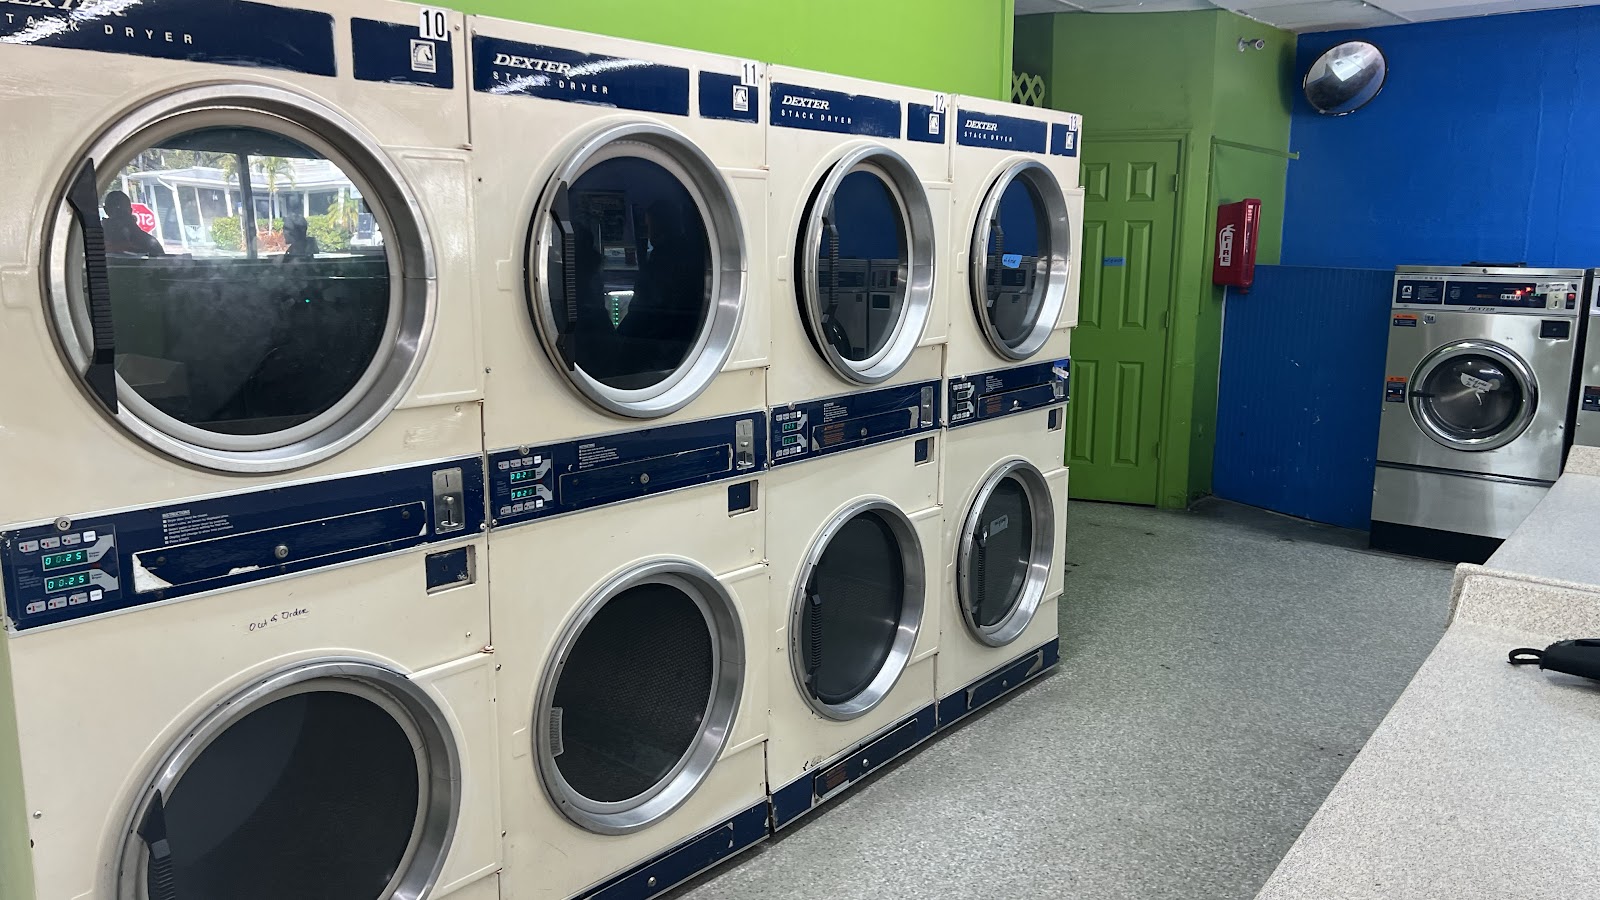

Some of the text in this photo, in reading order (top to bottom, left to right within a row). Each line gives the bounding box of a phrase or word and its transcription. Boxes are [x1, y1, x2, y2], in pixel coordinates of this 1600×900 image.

[422, 10, 446, 38] 10
[104, 24, 193, 44] DRYER
[493, 53, 572, 75] DEXTER
[743, 63, 756, 85] 11
[558, 79, 609, 95] DRYER
[782, 95, 830, 110] DEXTER
[935, 94, 944, 112] 12
[781, 109, 852, 125] STACK DRYER
[965, 120, 998, 131] DEXTER
[964, 131, 1013, 143] STACK DRYER
[1222, 235, 1231, 263] FIRE
[249, 619, 268, 631] Out
